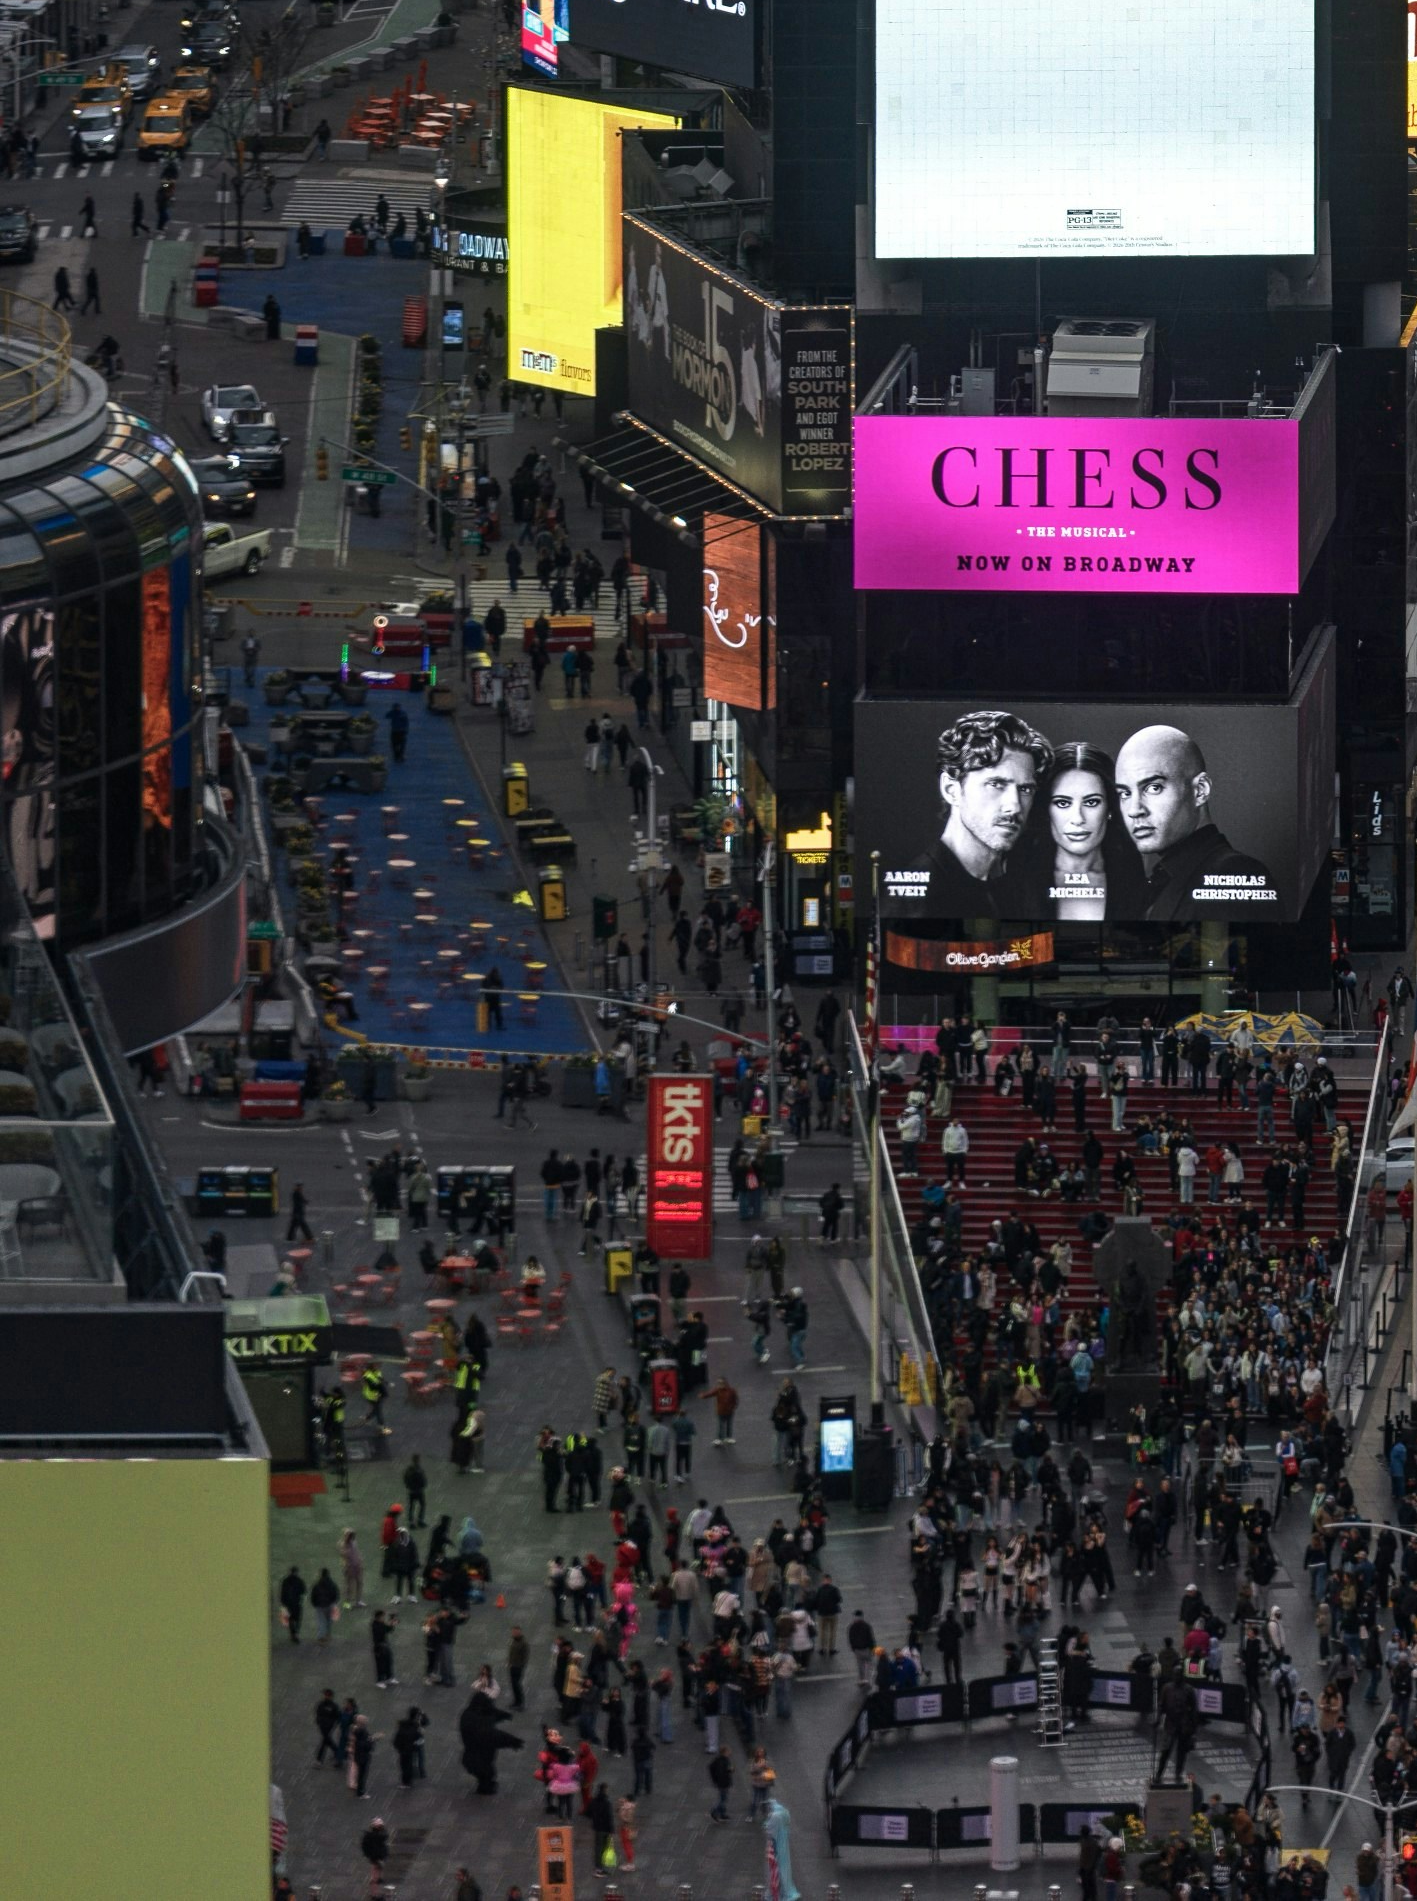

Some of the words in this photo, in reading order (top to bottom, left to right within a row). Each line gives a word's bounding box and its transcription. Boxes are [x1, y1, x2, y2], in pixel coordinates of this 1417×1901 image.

[796, 350, 821, 363] FROM
[821, 350, 838, 363] THE
[560, 358, 592, 382] flavors
[788, 365, 833, 379] CREATORS
[834, 365, 846, 379] OF
[787, 380, 848, 394] SOUTH
[794, 395, 841, 409] PARK
[795, 411, 815, 425] AND
[816, 411, 839, 425] EGOT
[799, 427, 835, 440] WINNER
[784, 442, 851, 456] ROBERT
[791, 457, 845, 472] LOPEZ
[930, 445, 1224, 511] CHESS
[1027, 526, 1056, 538] THE
[1060, 526, 1127, 539] MUSICAL
[956, 554, 1012, 572] NOW
[1021, 554, 1053, 573] ON
[1062, 554, 1197, 574] BROADWAY
[1371, 790, 1383, 836] Lids
[884, 871, 931, 883] AARON
[1064, 873, 1090, 885] LEA
[1203, 874, 1267, 887] NICHOLAS
[886, 884, 928, 898] TVEIT
[1049, 886, 1105, 899] MICHELE
[1192, 887, 1278, 901] CHRISTOPHER
[945, 951, 979, 966] Olive
[979, 950, 1020, 966] Garden
[663, 1081, 703, 1164] tkts
[224, 1333, 318, 1357] KLIKTIX
